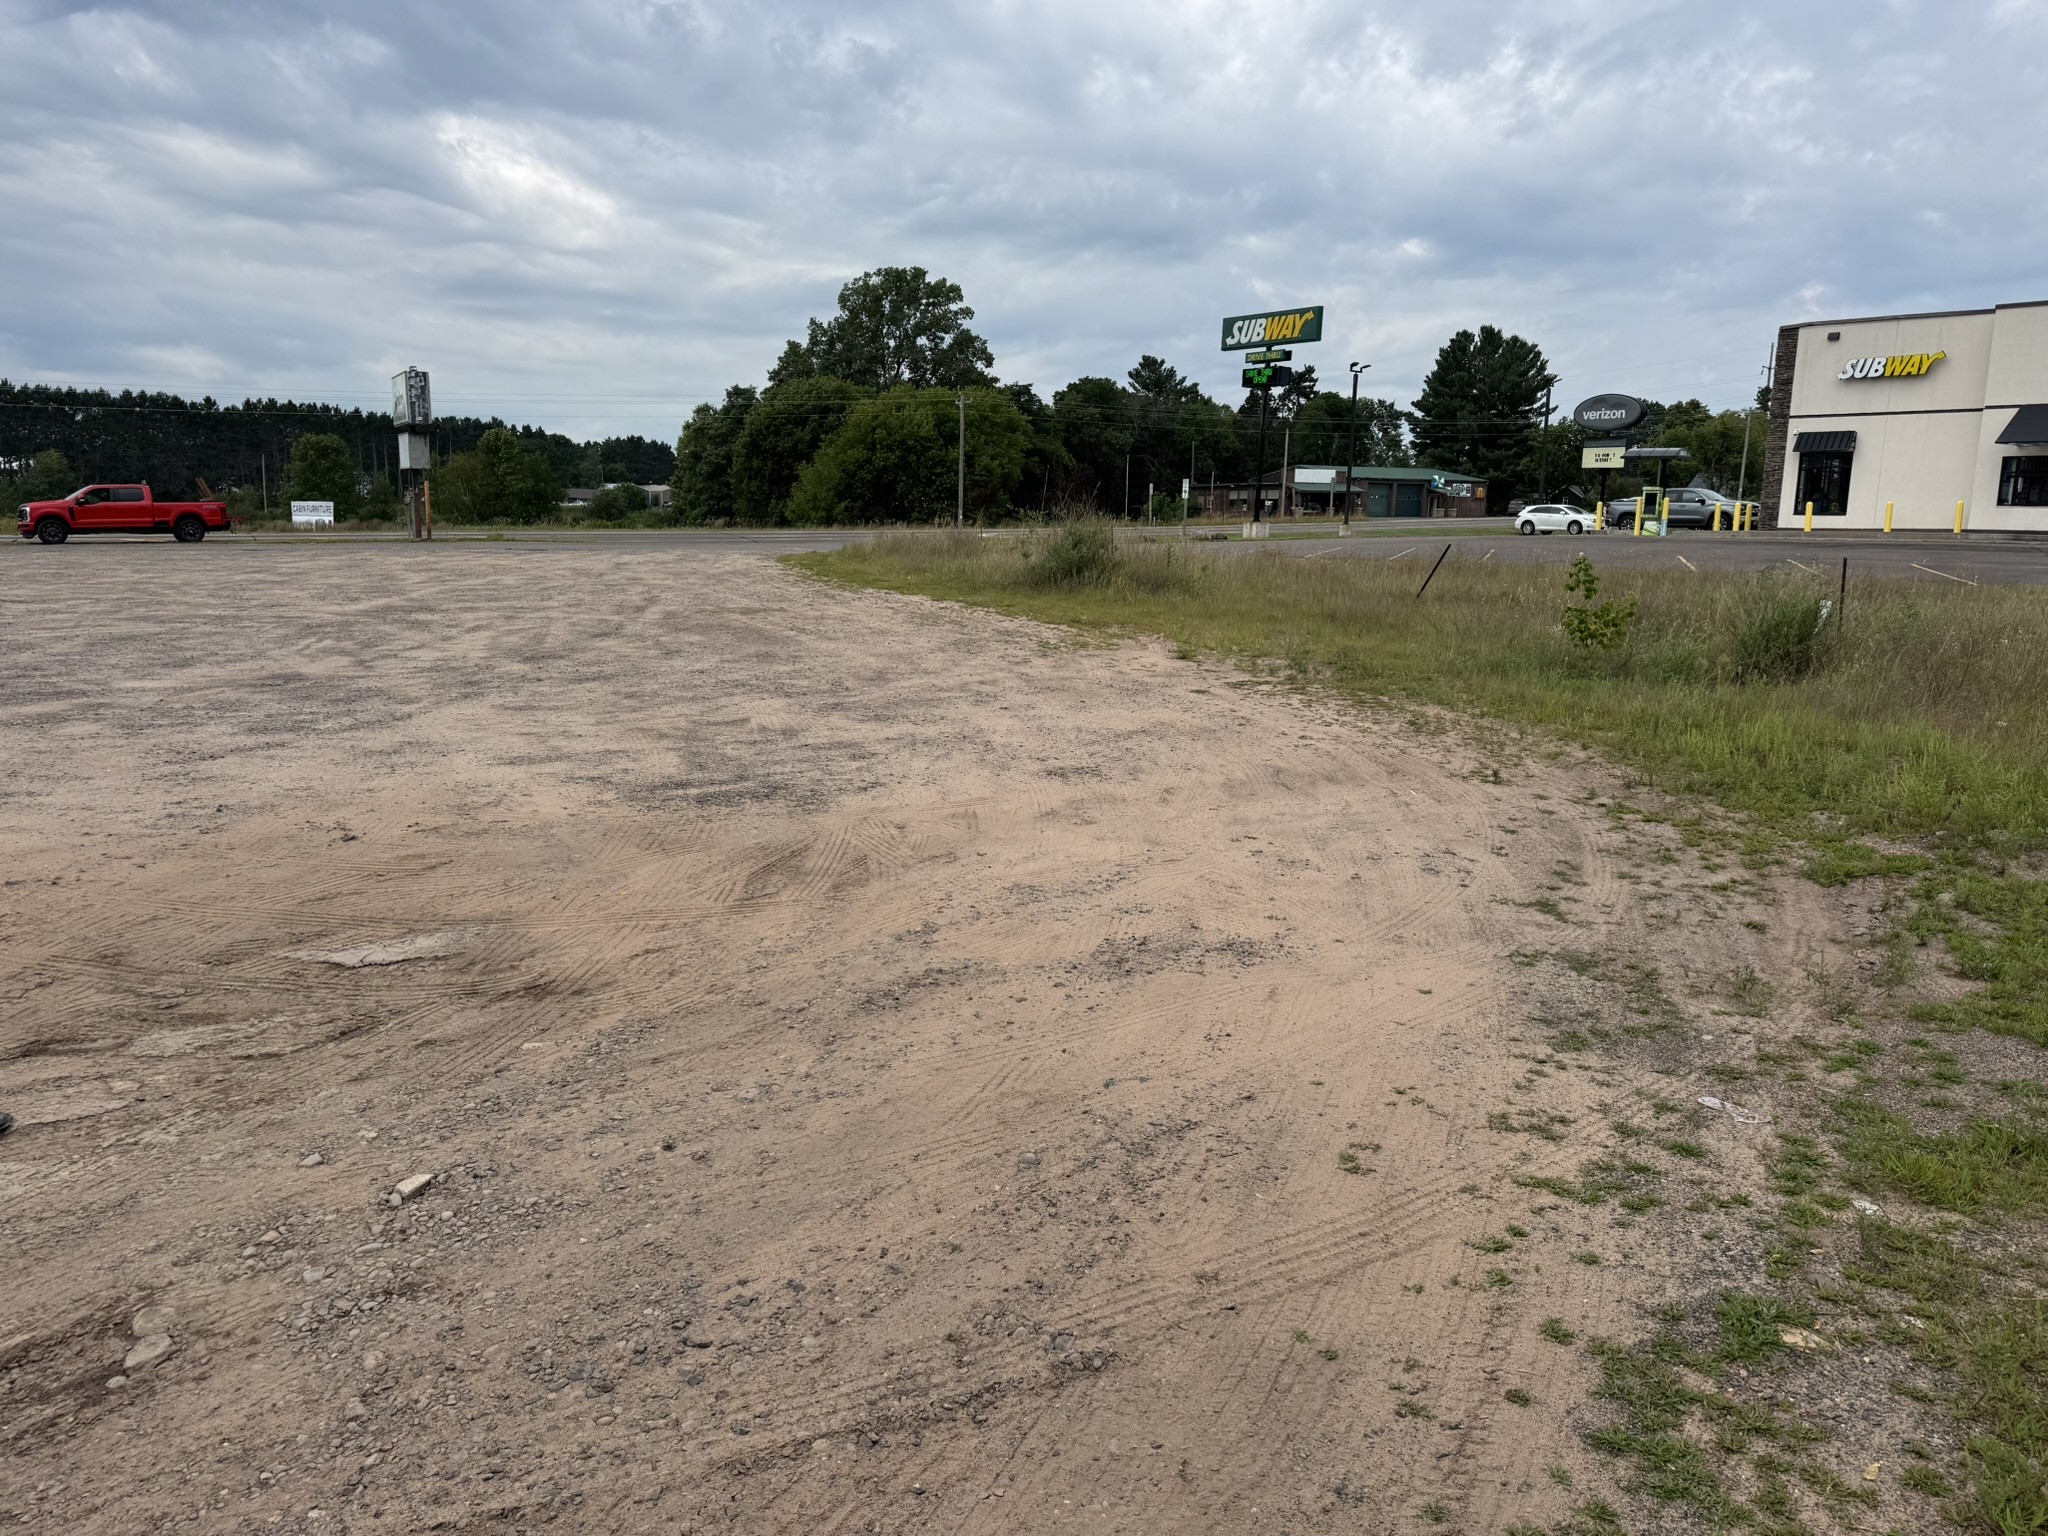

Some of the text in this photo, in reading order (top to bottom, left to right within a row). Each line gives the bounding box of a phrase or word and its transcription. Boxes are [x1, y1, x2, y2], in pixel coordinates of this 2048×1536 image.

[1226, 310, 1314, 346] SUBWAY
[1837, 350, 1946, 380] SUBWAY
[1583, 408, 1626, 420] verizon
